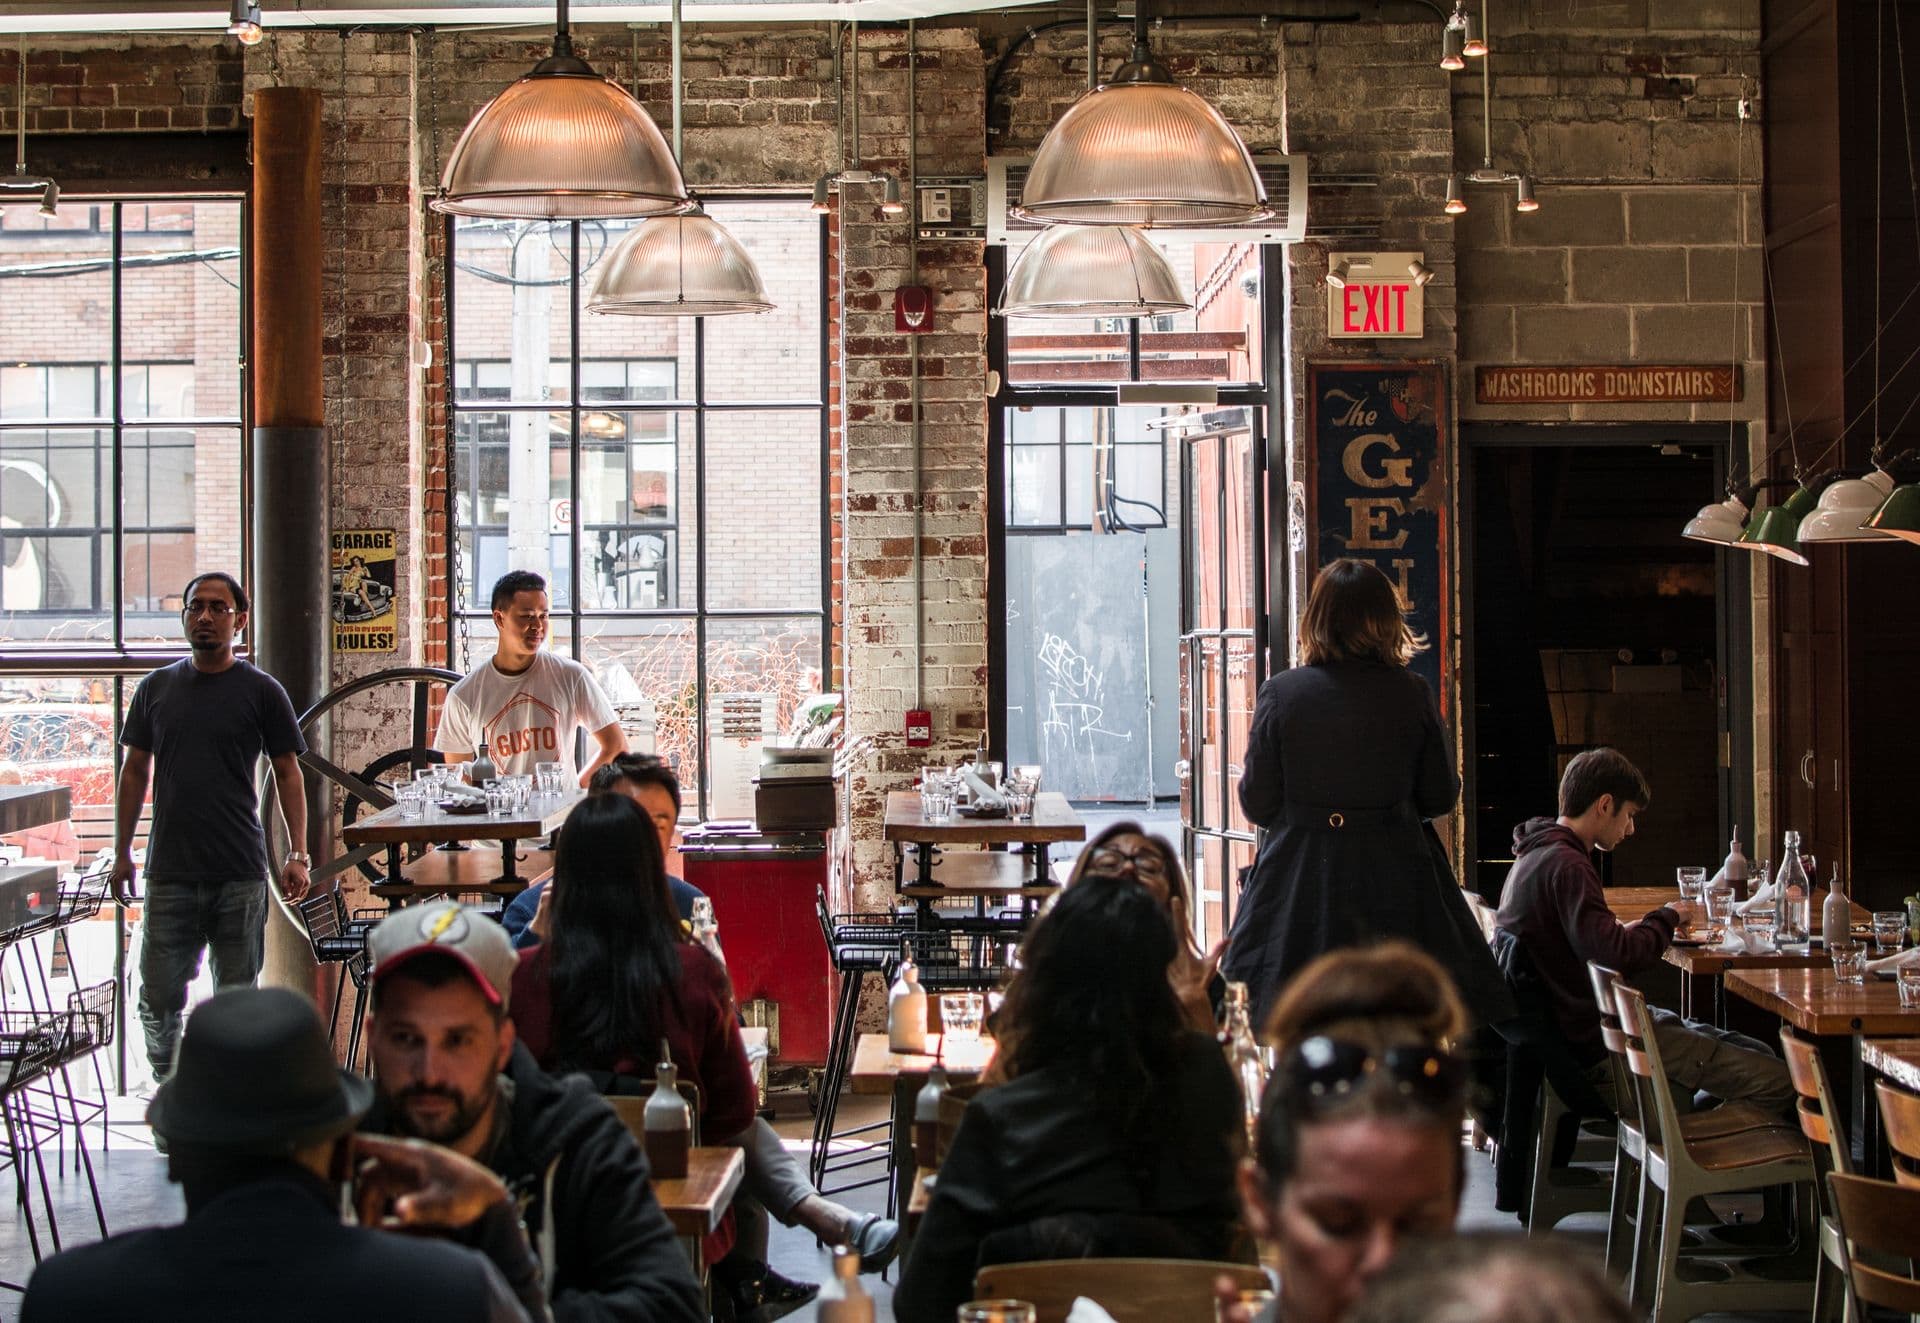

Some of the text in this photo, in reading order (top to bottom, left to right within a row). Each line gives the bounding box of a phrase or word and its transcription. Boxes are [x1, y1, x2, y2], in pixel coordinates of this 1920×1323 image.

[1343, 284, 1410, 333] EXIT
[1485, 371, 1715, 398] WASHROOMS DOWNSTAIRS
[1324, 389, 1378, 427] The
[333, 533, 393, 549] GARAGE
[336, 633, 394, 649] RULES!
[496, 726, 557, 757] GUSTO
